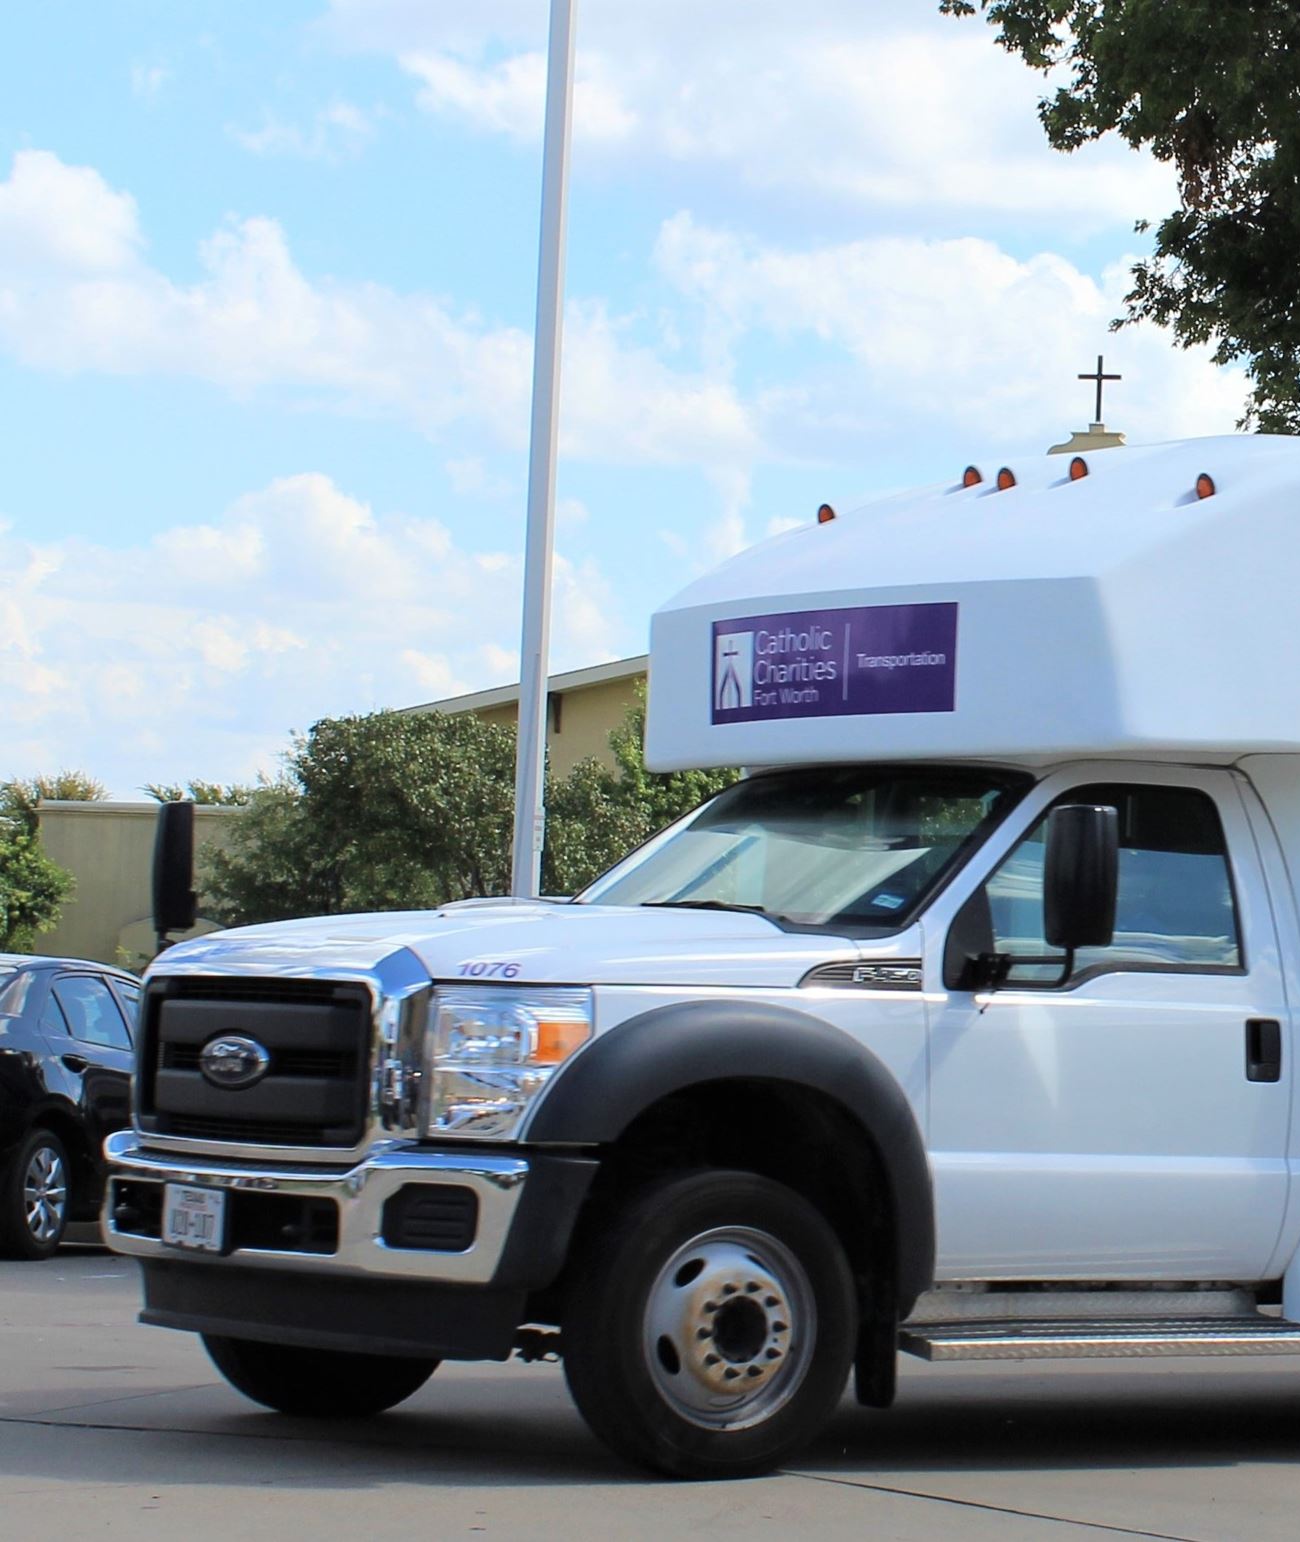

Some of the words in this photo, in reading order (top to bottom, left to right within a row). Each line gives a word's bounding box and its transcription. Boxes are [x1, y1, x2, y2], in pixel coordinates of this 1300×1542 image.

[755, 625, 833, 655] Catholic
[754, 656, 837, 685] Charities
[856, 651, 946, 670] Transportation
[754, 689, 778, 706] Fort
[779, 686, 820, 704] Worth
[457, 962, 522, 978] 1076
